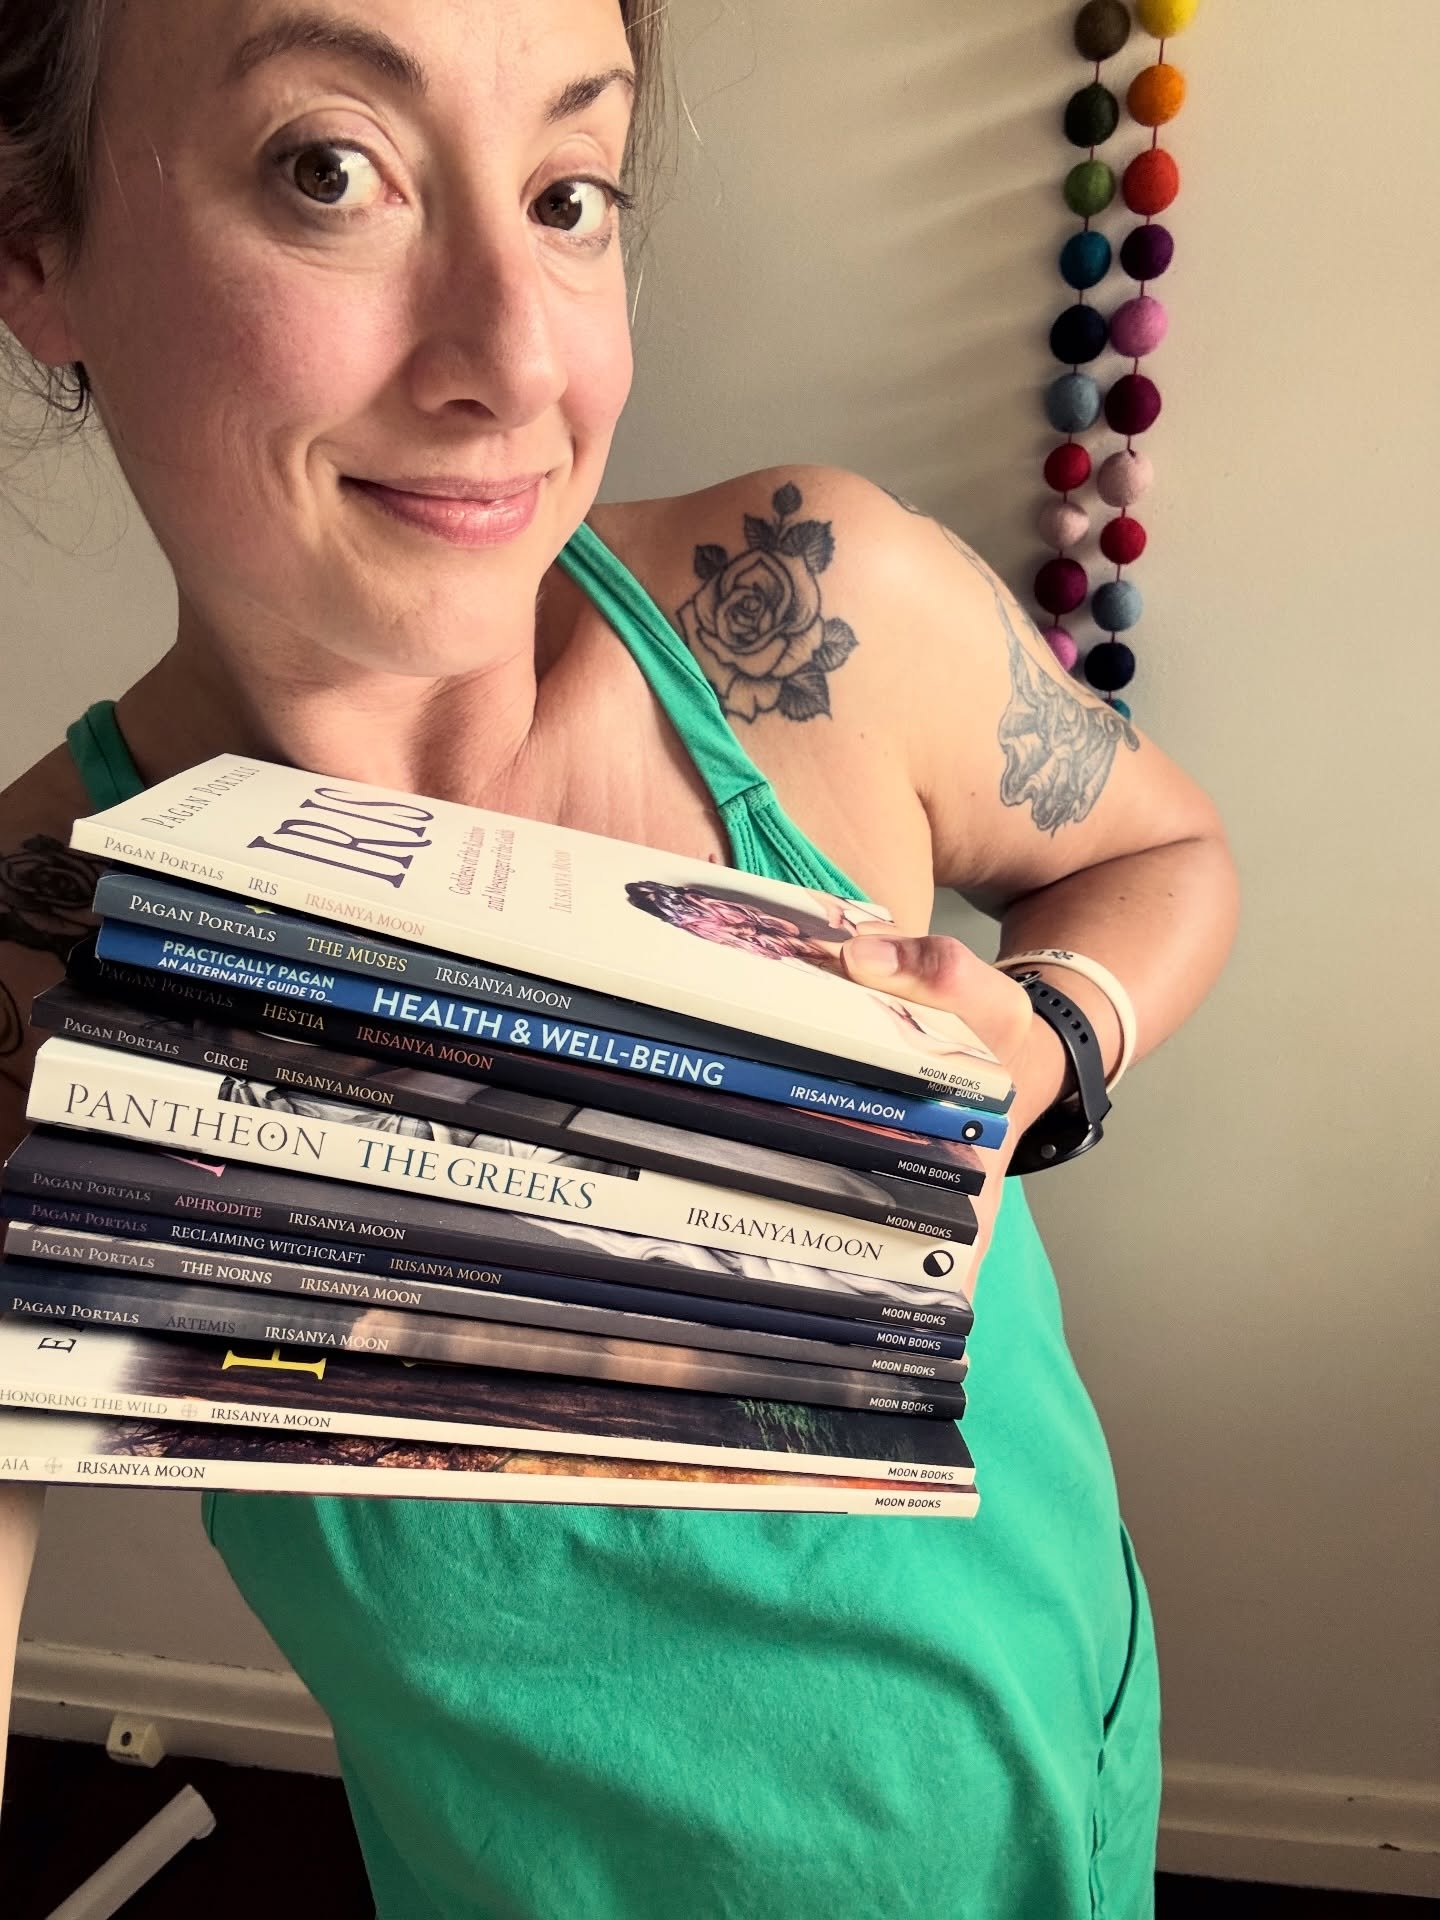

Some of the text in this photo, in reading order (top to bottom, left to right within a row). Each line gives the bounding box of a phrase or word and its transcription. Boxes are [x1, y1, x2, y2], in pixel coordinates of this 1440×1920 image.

[141, 765, 261, 830] PAGAN PORTALS
[246, 787, 434, 889] IRIS
[104, 836, 425, 937] PAGAN PORTALS IRIS IRISANYA MOON
[448, 864, 476, 896] Goddess
[481, 894, 505, 912] and
[129, 895, 573, 1010] PAGAN PORTALS THE MUSES IRISANYA MOON
[163, 940, 335, 989] PRACTICALLY PAGAN
[157, 957, 179, 970] AN
[181, 961, 266, 989] ALTERNATIVE
[267, 980, 306, 998] GUIDE
[98, 962, 495, 1071] PAGAN PORTALS HESTIA IRISANYA MOON
[372, 987, 726, 1086] HEALTH & WELL-BEING
[63, 1016, 394, 1105] PAGAN PORTALS CIRCE IRISANYA MOON
[918, 1066, 981, 1091] MOON BOOKS
[790, 1085, 906, 1121] IRISANYA MOON
[65, 1083, 596, 1210] PANTHEON THE GREEKS
[897, 1160, 961, 1184] MOON BOOKS
[32, 1172, 406, 1241] PAGAN PORTALS APHRODITE IRISANYA MOON
[885, 1214, 952, 1239] MOON BOOKS
[31, 1204, 503, 1285] PAGAN PORTALS RECLAIMING WITCHCRAFT IRISANYA MOON
[686, 1207, 884, 1261] IRISANYA MOON
[31, 1239, 422, 1305] PAGAN PORTALS THE NORNS IRISANYA MOON
[12, 1297, 390, 1351] PAGAN PORTALS ARTEMIS IRISANYA MOON
[881, 1307, 946, 1326] MOON BOOKS
[876, 1332, 941, 1351] MOON BOOKS
[871, 1359, 936, 1377] MOON BOOKS
[0, 1388, 331, 1428] HONORING THE WILD IRISANYA MOON
[869, 1397, 934, 1413] MOON BOOKS
[76, 1461, 150, 1477] IRISANYA
[154, 1465, 206, 1479] MOON
[887, 1467, 954, 1481] MOON BOOKS
[874, 1497, 941, 1509] MOON BOOKS
